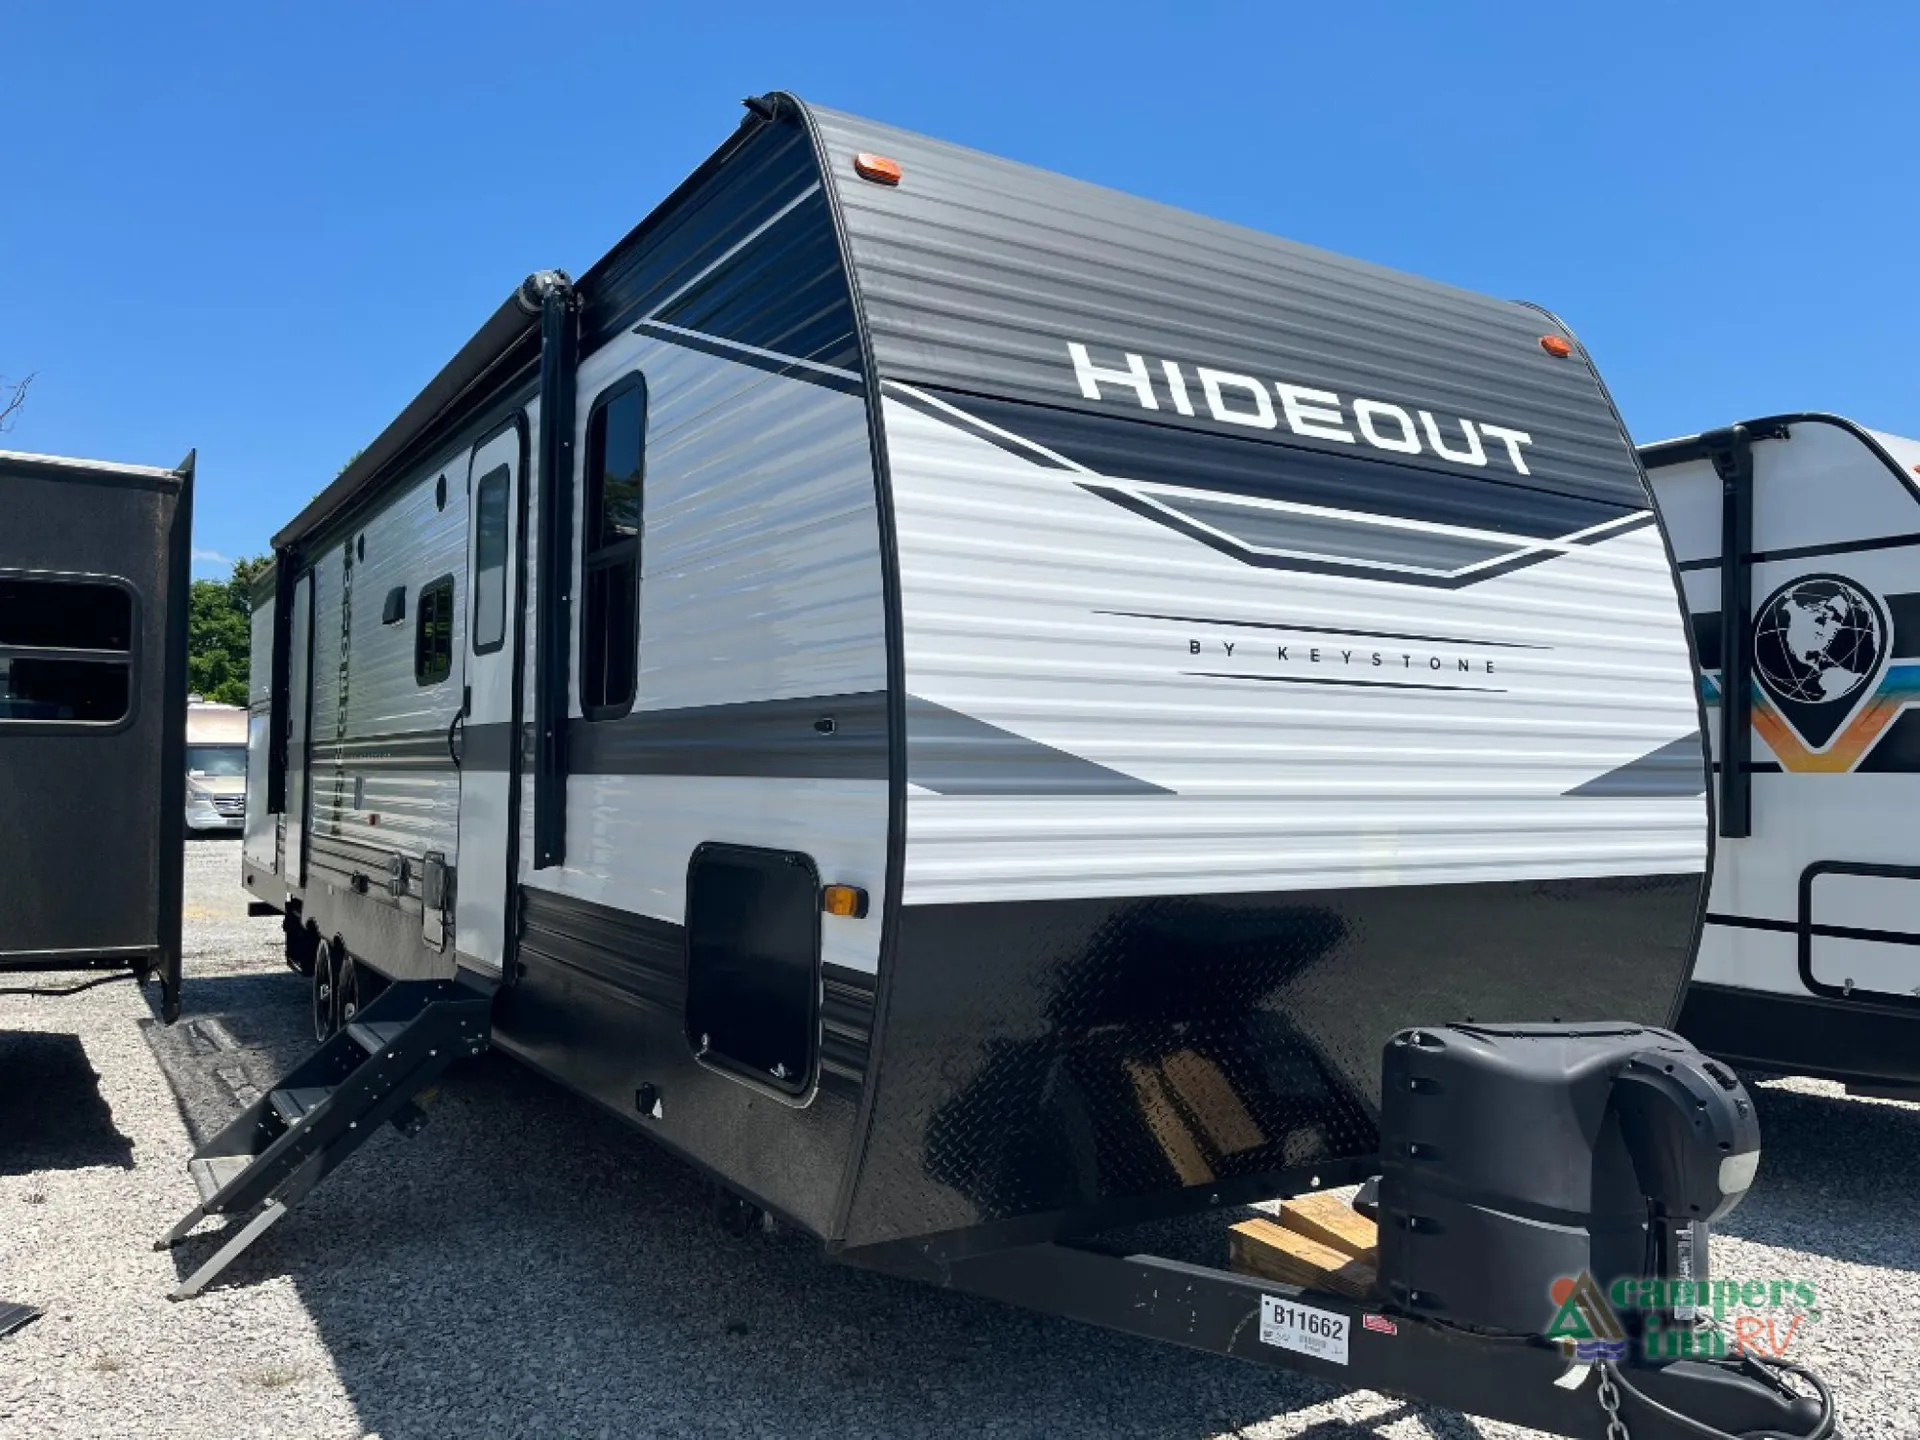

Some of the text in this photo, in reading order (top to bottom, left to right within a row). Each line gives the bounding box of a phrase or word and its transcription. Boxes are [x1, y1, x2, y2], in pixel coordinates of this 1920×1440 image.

[1067, 342, 1533, 475] HIDEOUT
[1190, 639, 1496, 674] BY KEYSTONE
[1274, 1304, 1343, 1341] B11662
